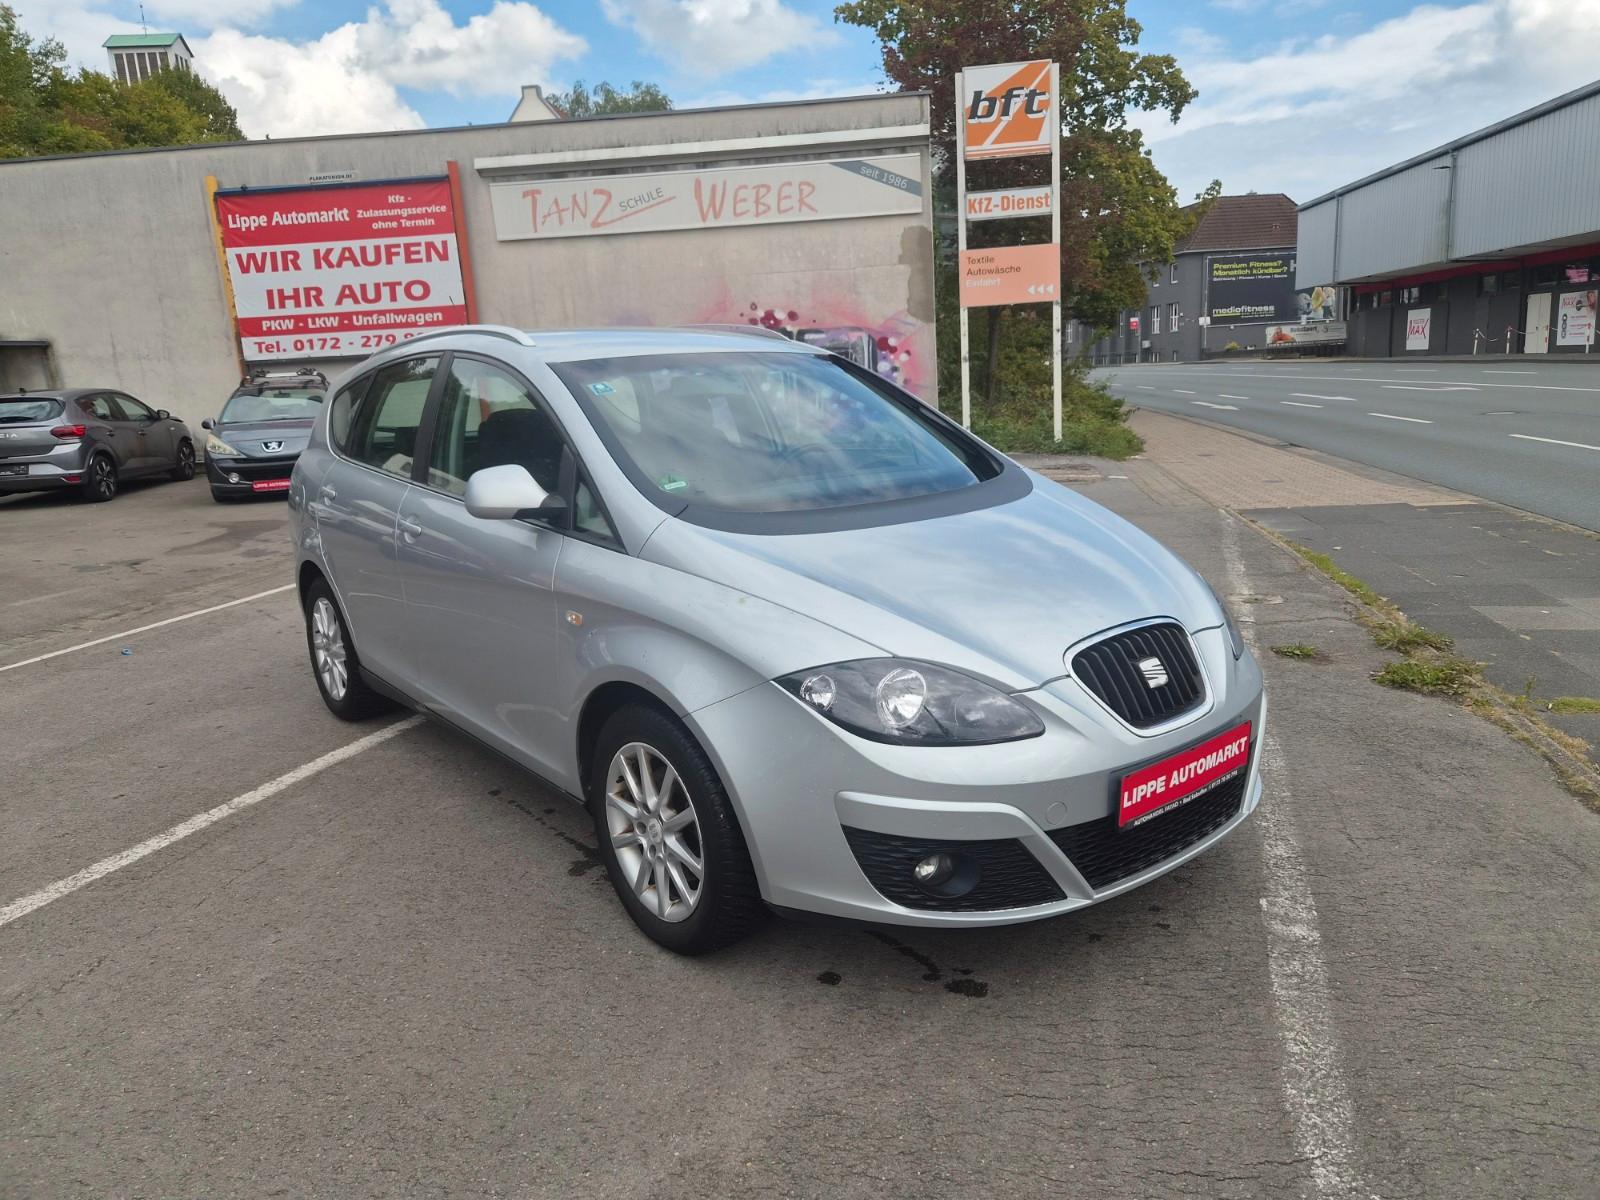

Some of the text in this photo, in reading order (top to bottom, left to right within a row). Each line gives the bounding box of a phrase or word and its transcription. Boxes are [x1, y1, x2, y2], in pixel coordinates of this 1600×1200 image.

[968, 86, 1049, 122] bft
[859, 164, 908, 189] seit 1986
[388, 194, 405, 204] Kfz
[522, 177, 818, 234] TANZ SCHULE WEBER
[967, 192, 1050, 215] KfZ-Dienst
[228, 207, 350, 231] Lippe Automarkt
[356, 204, 447, 219] Zulassungsservice
[372, 217, 435, 230] ohne Termin
[235, 239, 449, 275] WIR KAUFEN
[967, 255, 994, 265] Textile
[1213, 261, 1247, 269] Premium
[966, 265, 1021, 277] Autowäsche
[1213, 268, 1250, 276] Monatlich
[266, 279, 431, 310] IHR AUTO
[1213, 305, 1275, 314] mediofitness
[262, 319, 294, 332] PKW
[308, 316, 339, 329] LKW
[352, 312, 443, 327] Unfallwagen
[254, 340, 287, 354] Tel.
[293, 336, 341, 351] 0172
[361, 333, 396, 349] 279
[1123, 777, 1166, 808] LIPPE
[1169, 736, 1248, 788] AUTOMARKT
